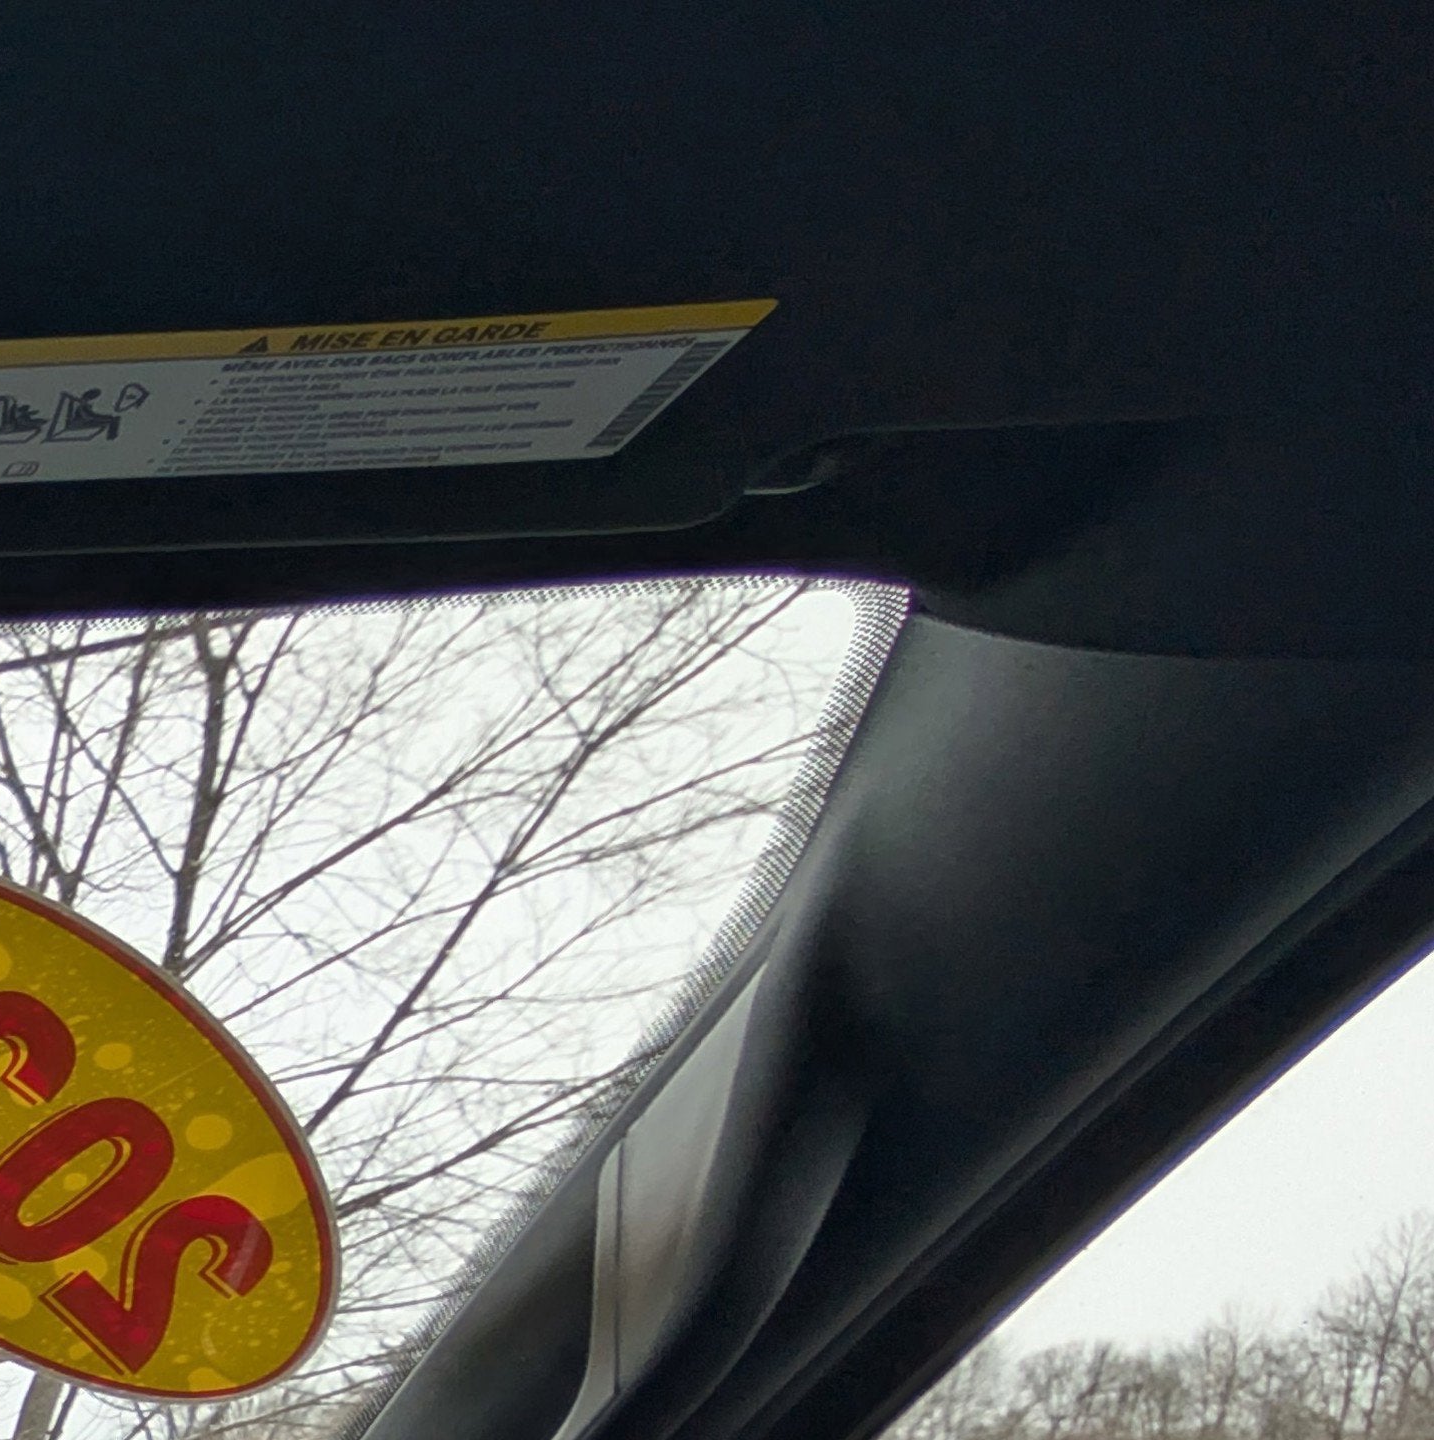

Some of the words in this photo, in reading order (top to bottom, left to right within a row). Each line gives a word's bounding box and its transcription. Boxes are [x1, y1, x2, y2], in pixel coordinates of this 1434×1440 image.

[289, 331, 378, 350] MISE
[378, 328, 431, 347] EN
[432, 321, 552, 344] GARDE
